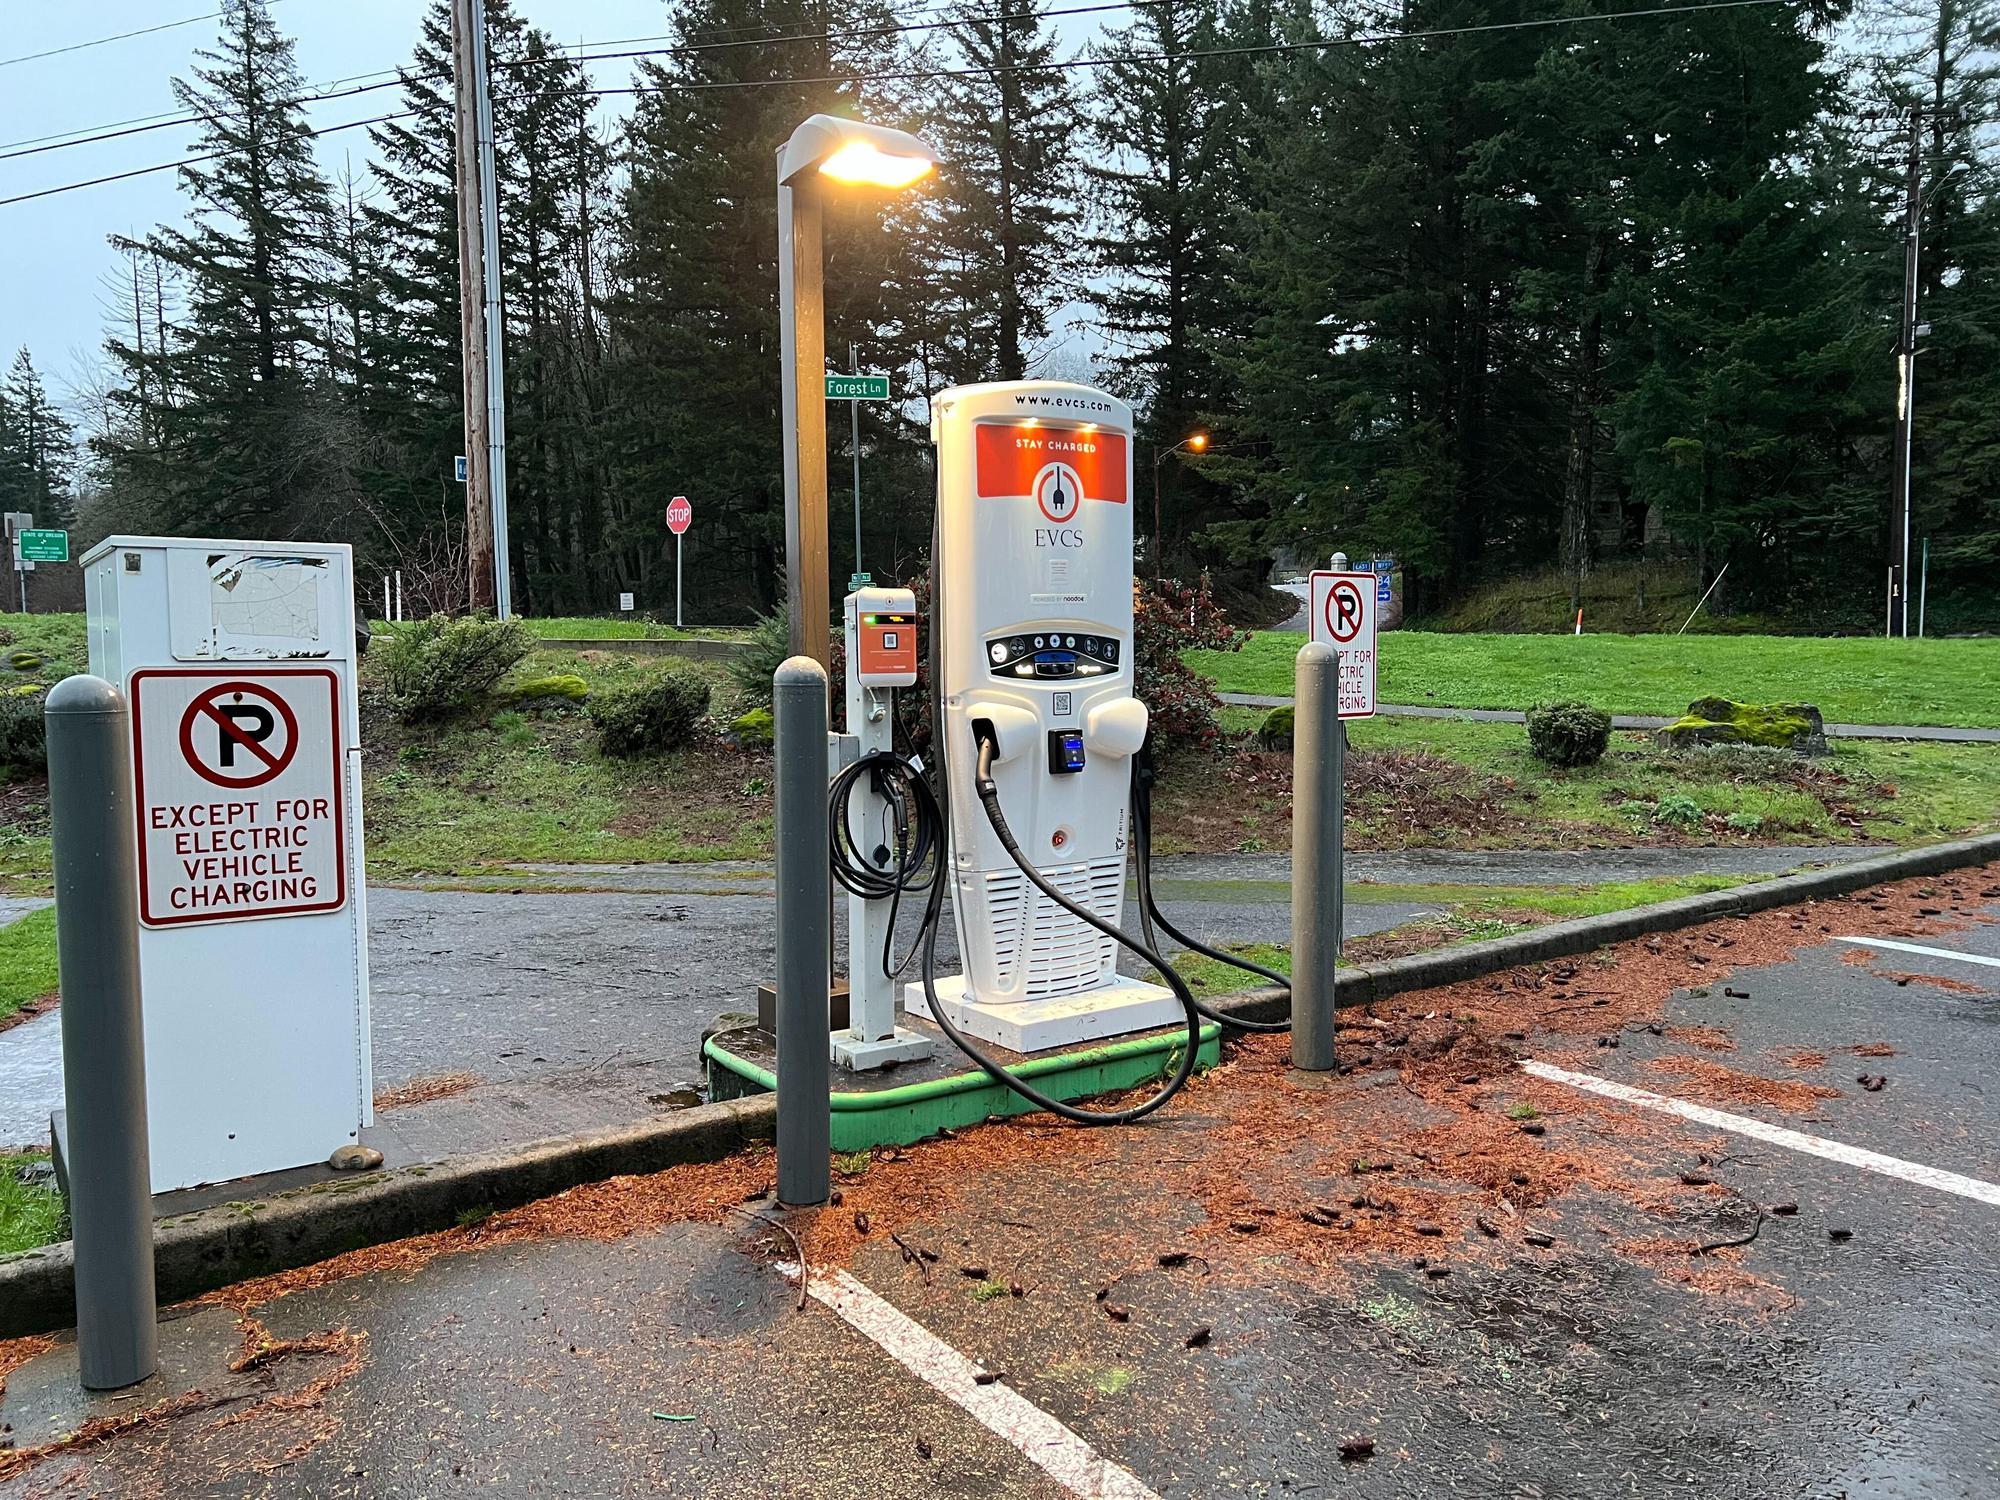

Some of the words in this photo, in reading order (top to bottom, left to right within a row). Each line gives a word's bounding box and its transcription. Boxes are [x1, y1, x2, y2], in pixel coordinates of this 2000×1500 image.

[828, 380, 868, 395] Forest
[870, 383, 881, 393] Ln
[1015, 395, 1112, 413] www.evcs.com
[1016, 438, 1043, 449] STAY
[1048, 440, 1097, 453] CHARGED
[668, 508, 689, 523] STOP
[1034, 529, 1084, 548] EVCS
[1378, 575, 1390, 586] 84
[1354, 650, 1371, 663] FOR
[1338, 665, 1365, 678] CTRIC
[1338, 681, 1362, 694] HICLE
[1339, 696, 1366, 710] RGING
[151, 802, 259, 830] EXCEPT
[276, 798, 329, 822] FOR
[175, 825, 309, 855] ELECTRIC
[183, 852, 303, 881] VEHICLE
[170, 876, 317, 909] CHARGING
